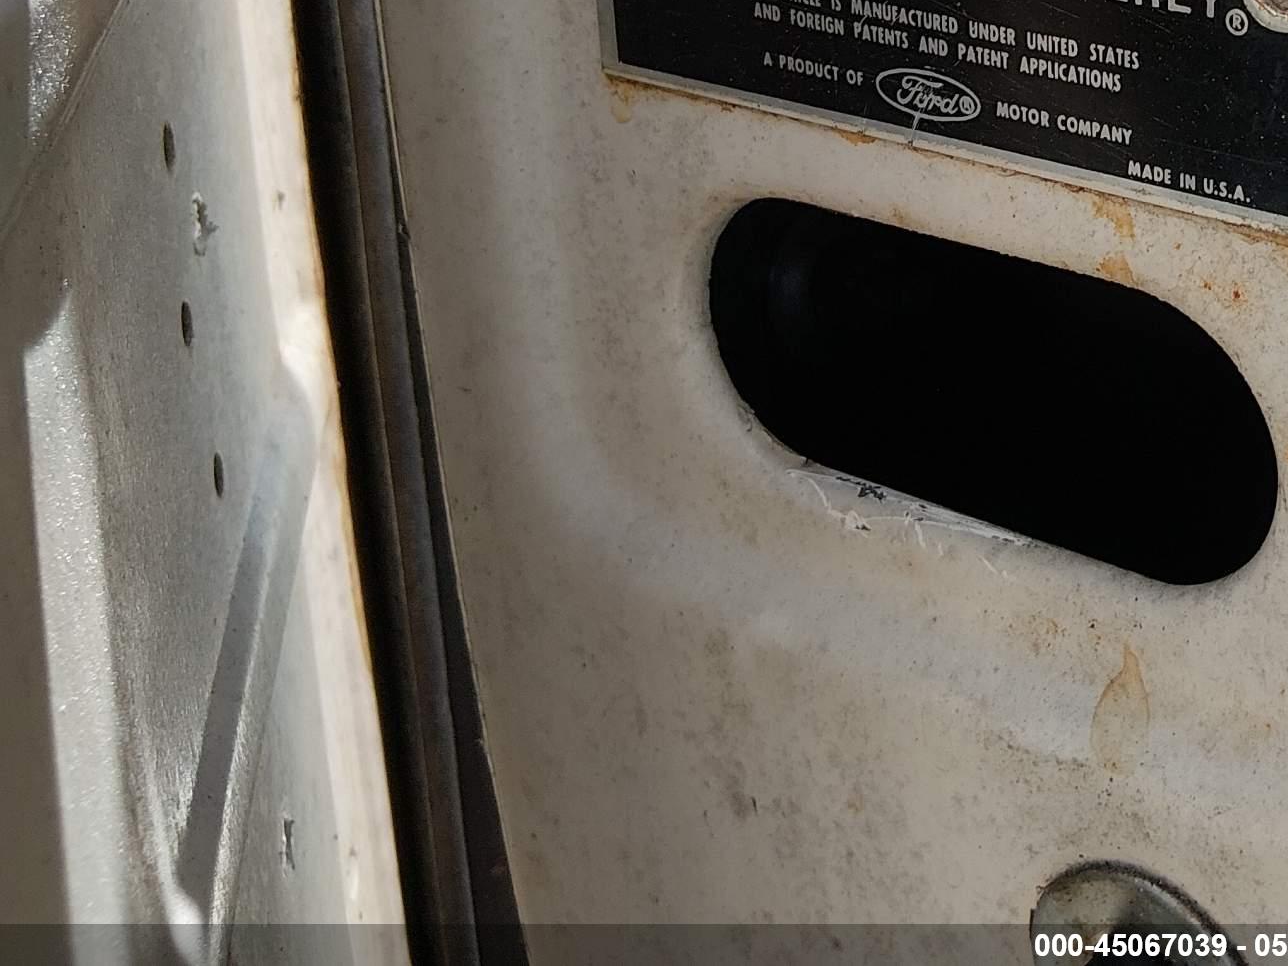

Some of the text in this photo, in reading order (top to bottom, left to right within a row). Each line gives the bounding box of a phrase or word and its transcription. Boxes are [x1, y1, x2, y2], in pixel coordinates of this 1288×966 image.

[754, 2, 1122, 93] AND FOREIGN PATENTS AND PATENT APPLICATIONS
[968, 20, 1016, 47] UNDER
[1026, 31, 1078, 58] UNITED
[1089, 43, 1140, 70] STATES
[763, 51, 773, 67] A
[779, 54, 840, 82] PRODUCT
[846, 69, 864, 86] OF
[996, 101, 1050, 128] MOTOR
[1057, 114, 1133, 146] COMPANY
[1127, 160, 1251, 203] MADE IN U.S.A.
